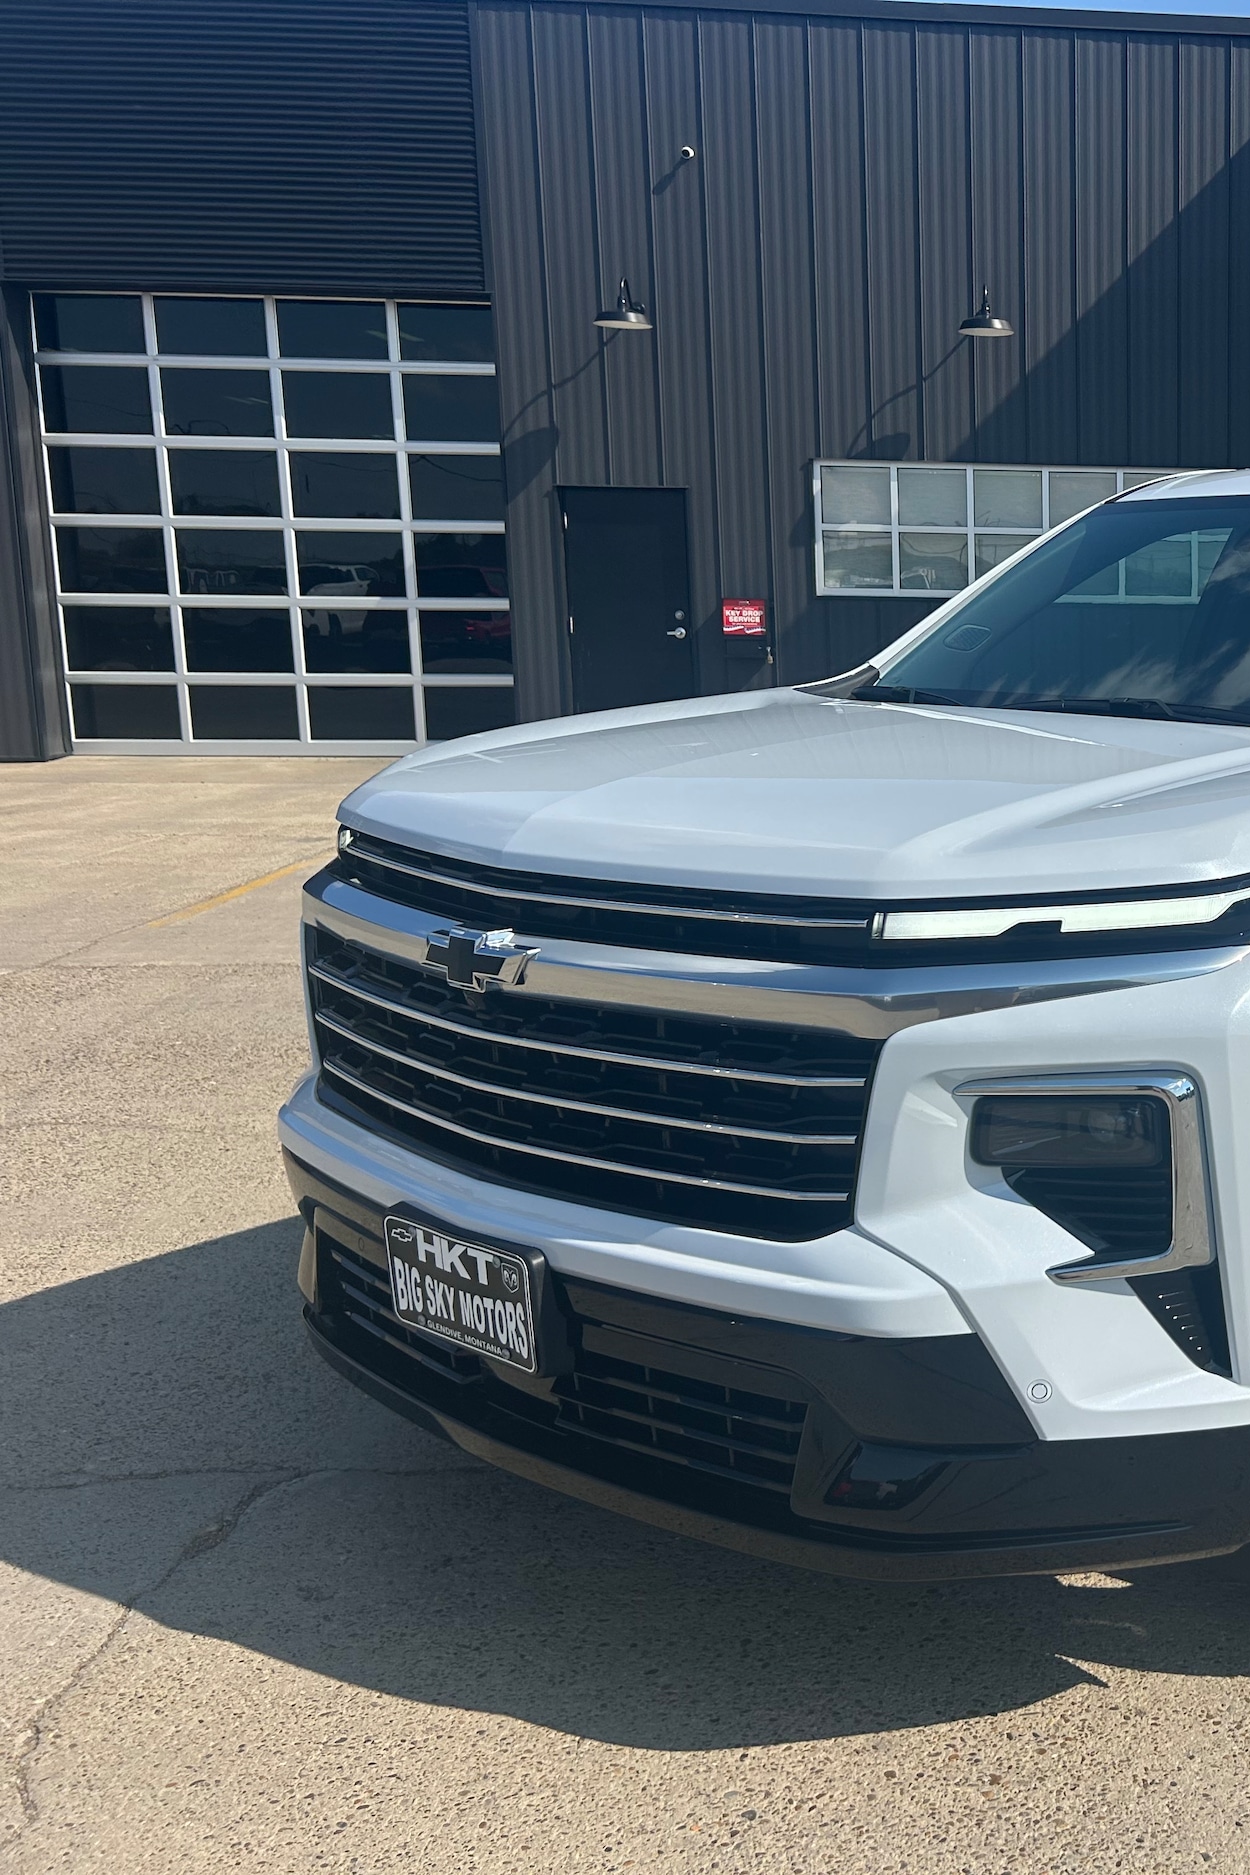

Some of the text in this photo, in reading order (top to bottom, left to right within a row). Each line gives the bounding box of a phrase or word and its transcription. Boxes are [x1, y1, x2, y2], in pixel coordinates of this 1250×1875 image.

[725, 609, 764, 617] KEY DROP
[415, 1228, 494, 1286] HKT
[393, 1256, 529, 1360] BIG SKY MOTORS
[427, 1319, 503, 1356] GLENDIVE, MONTANA
